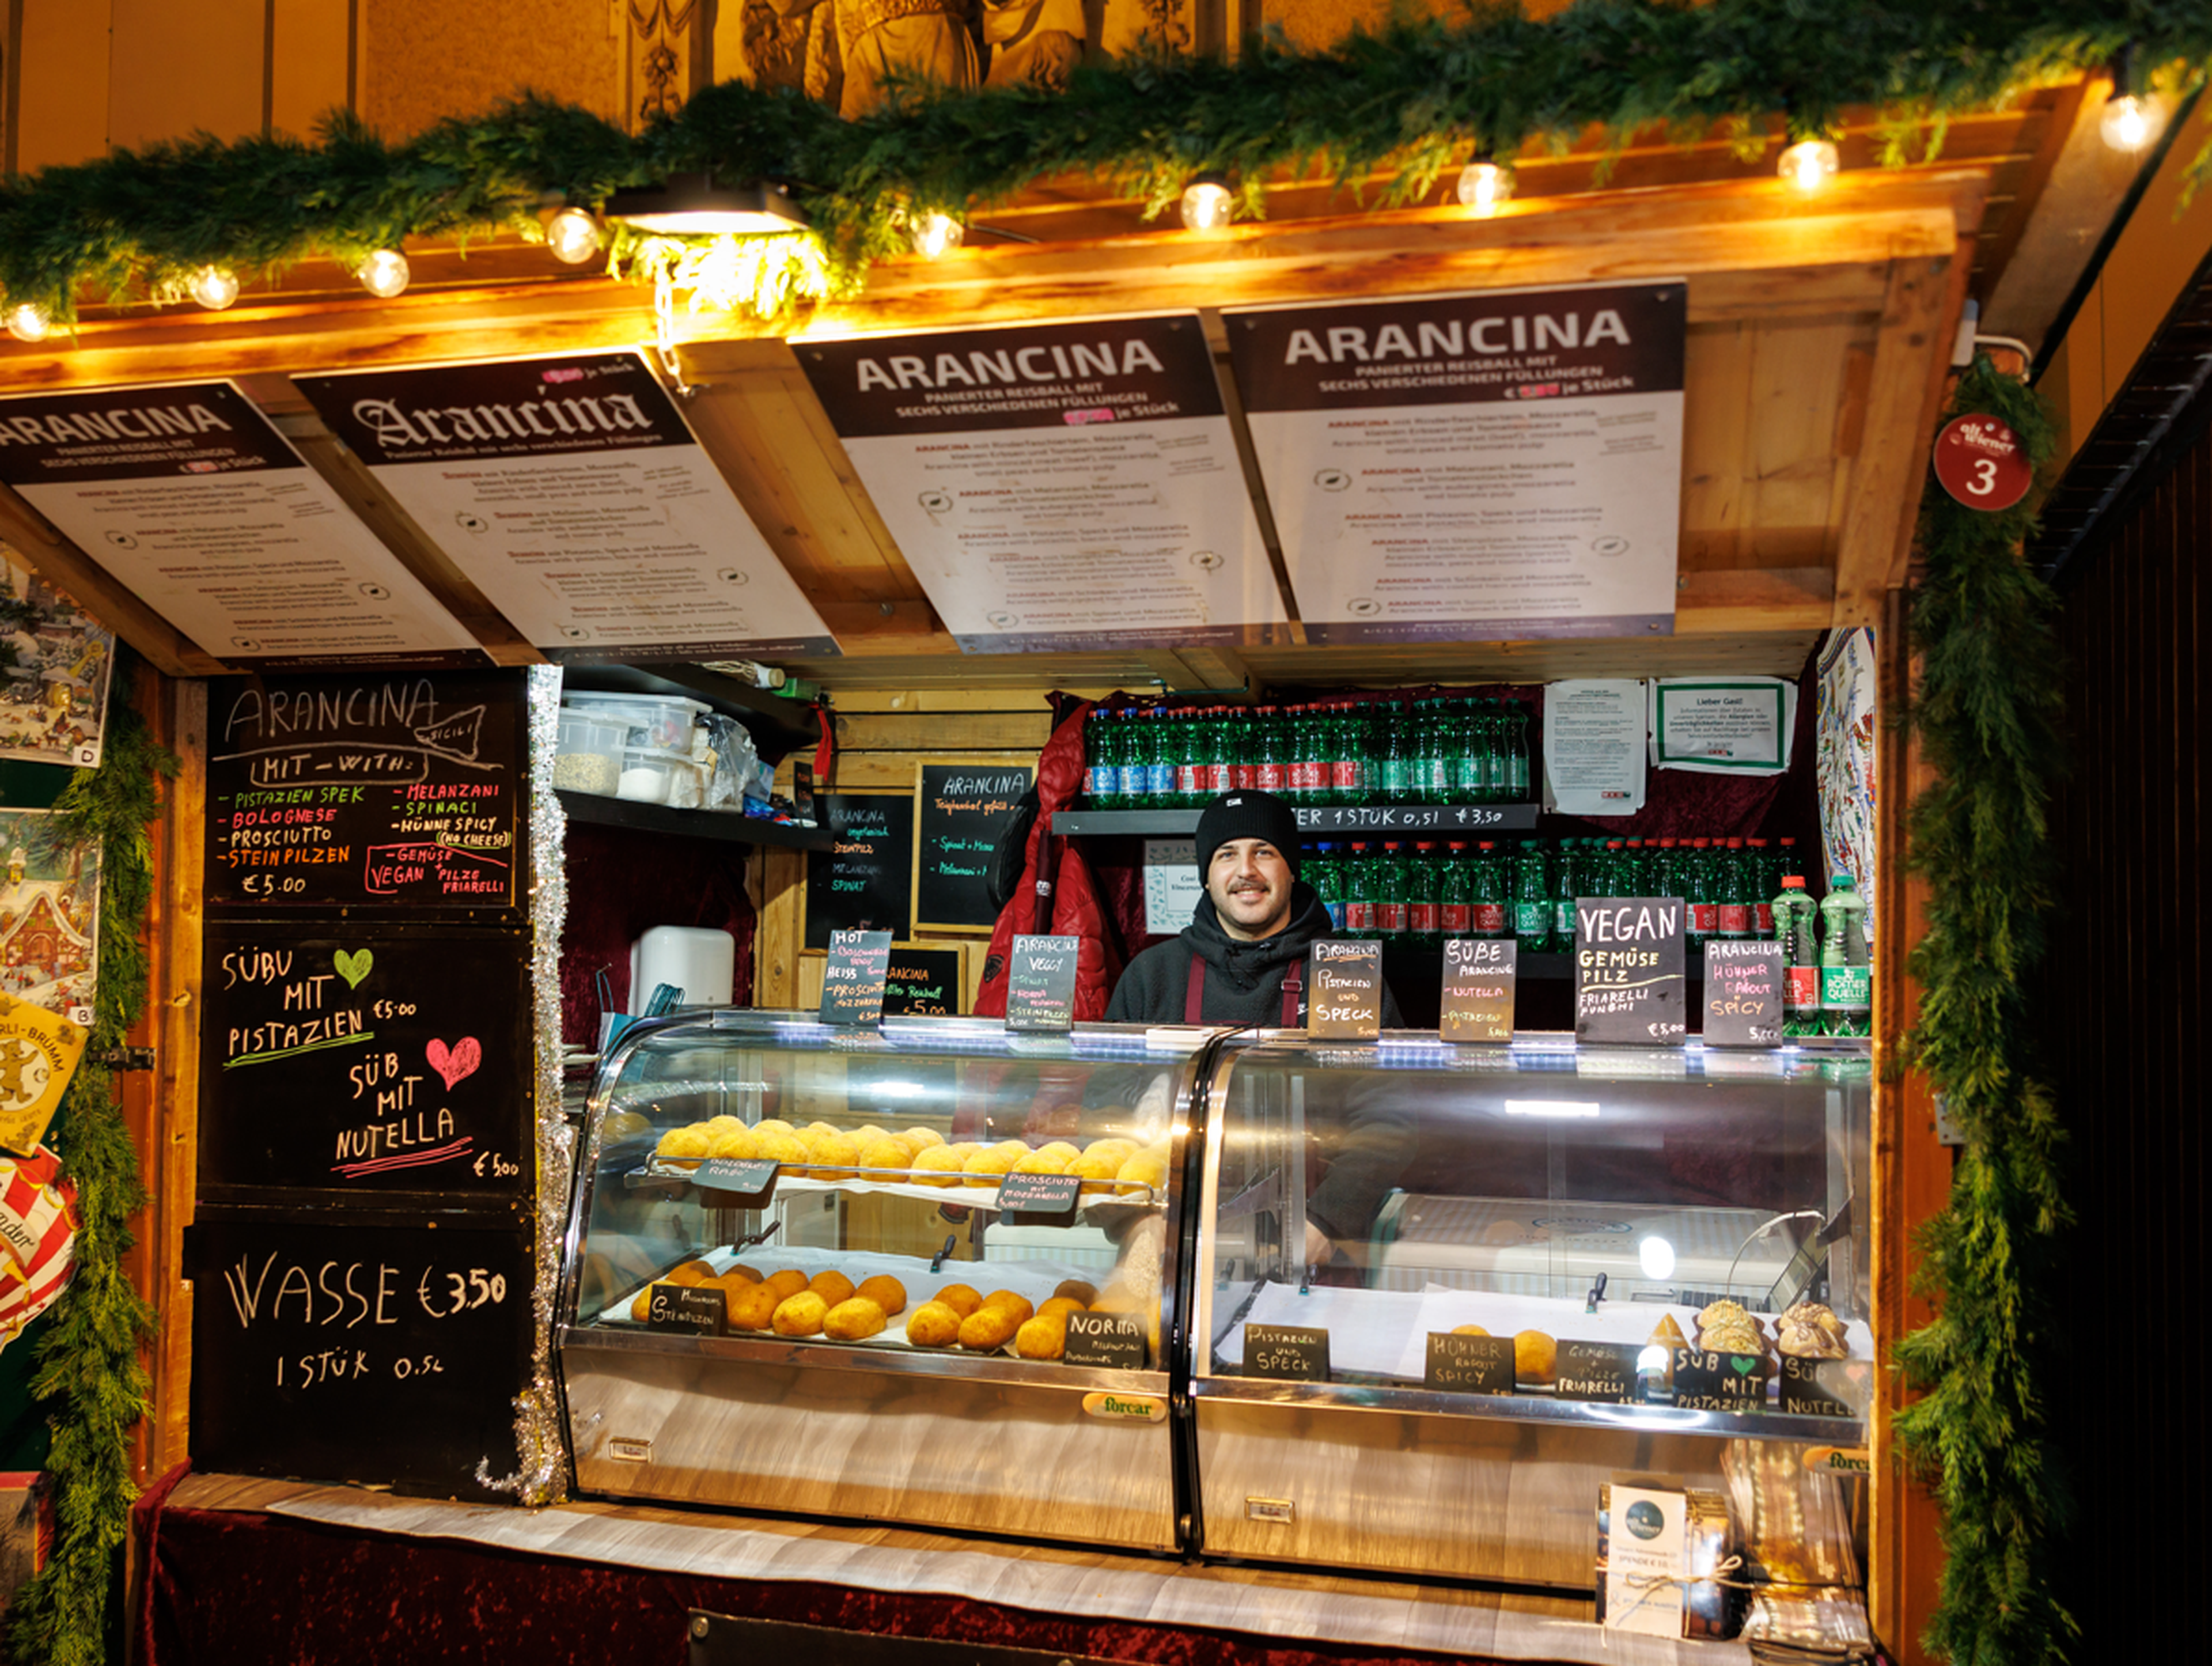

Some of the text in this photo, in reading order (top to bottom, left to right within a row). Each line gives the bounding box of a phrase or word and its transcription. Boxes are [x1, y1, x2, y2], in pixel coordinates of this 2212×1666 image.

[1285, 309, 1631, 365] ARANCINA
[857, 339, 1164, 392] ARANCINA
[1355, 355, 1557, 376] PANIERTER REISBALL MIT
[1319, 366, 1603, 392] SECHS VERSCHIEDENEN FÜLLUNGEN
[1562, 383, 1580, 395] je
[1582, 376, 1633, 391] Stück
[925, 383, 1104, 403] PANIERTER REISBALL MIT
[896, 393, 1147, 418] SECHS VERSCHIEDENEN FÜLLUNGEN
[1115, 401, 1179, 419] je Stück
[0, 404, 232, 445] ARANCINA
[353, 385, 653, 448] Arancina
[1967, 459, 1997, 495] 3
[225, 679, 438, 742] ARANCINA
[82, 749, 94, 763] D
[264, 754, 311, 782] MIT
[407, 783, 499, 801] MELANZANI
[943, 773, 1024, 795] ARANCINA
[236, 786, 365, 809] PISTAZIEN SPEK
[233, 808, 337, 829] BOLOGNESE
[406, 801, 476, 816] SPINACI
[1347, 808, 1395, 826] STÜK
[1473, 809, 1502, 825] 3,50
[455, 816, 497, 832] SPICY
[231, 826, 331, 848] PROSCIUTTO
[372, 865, 423, 888] VEGAN
[442, 880, 504, 894] FRIARELLI
[1580, 906, 1676, 942] VEGAN
[835, 930, 869, 944] HOT
[1579, 947, 1659, 968] GEMÜSE
[1709, 944, 1783, 960] ARANCINA
[826, 967, 857, 979] HEISS
[1029, 956, 1063, 972] VEGGY
[1582, 970, 1628, 983] PILZ
[285, 975, 335, 1010] MIT
[1453, 987, 1503, 998] NUTELLA
[1580, 988, 1648, 1007] FRIARELLI
[78, 1010, 88, 1022] B
[1316, 1004, 1373, 1021] SPECK
[229, 1010, 362, 1056] PISTAZIEN
[377, 1076, 423, 1116] MIT
[336, 1108, 454, 1160] NUTELLA
[224, 1251, 399, 1328] WASSE
[300, 1346, 369, 1389] STÜK
[1257, 1352, 1311, 1371] SPECK
[1435, 1368, 1485, 1384] SPICY
[1559, 1377, 1624, 1395] FRIARELLI
[1722, 1376, 1763, 1395] MIT
[1105, 1396, 1152, 1415] forcar
[1677, 1395, 1759, 1411] PISTAZIEN
